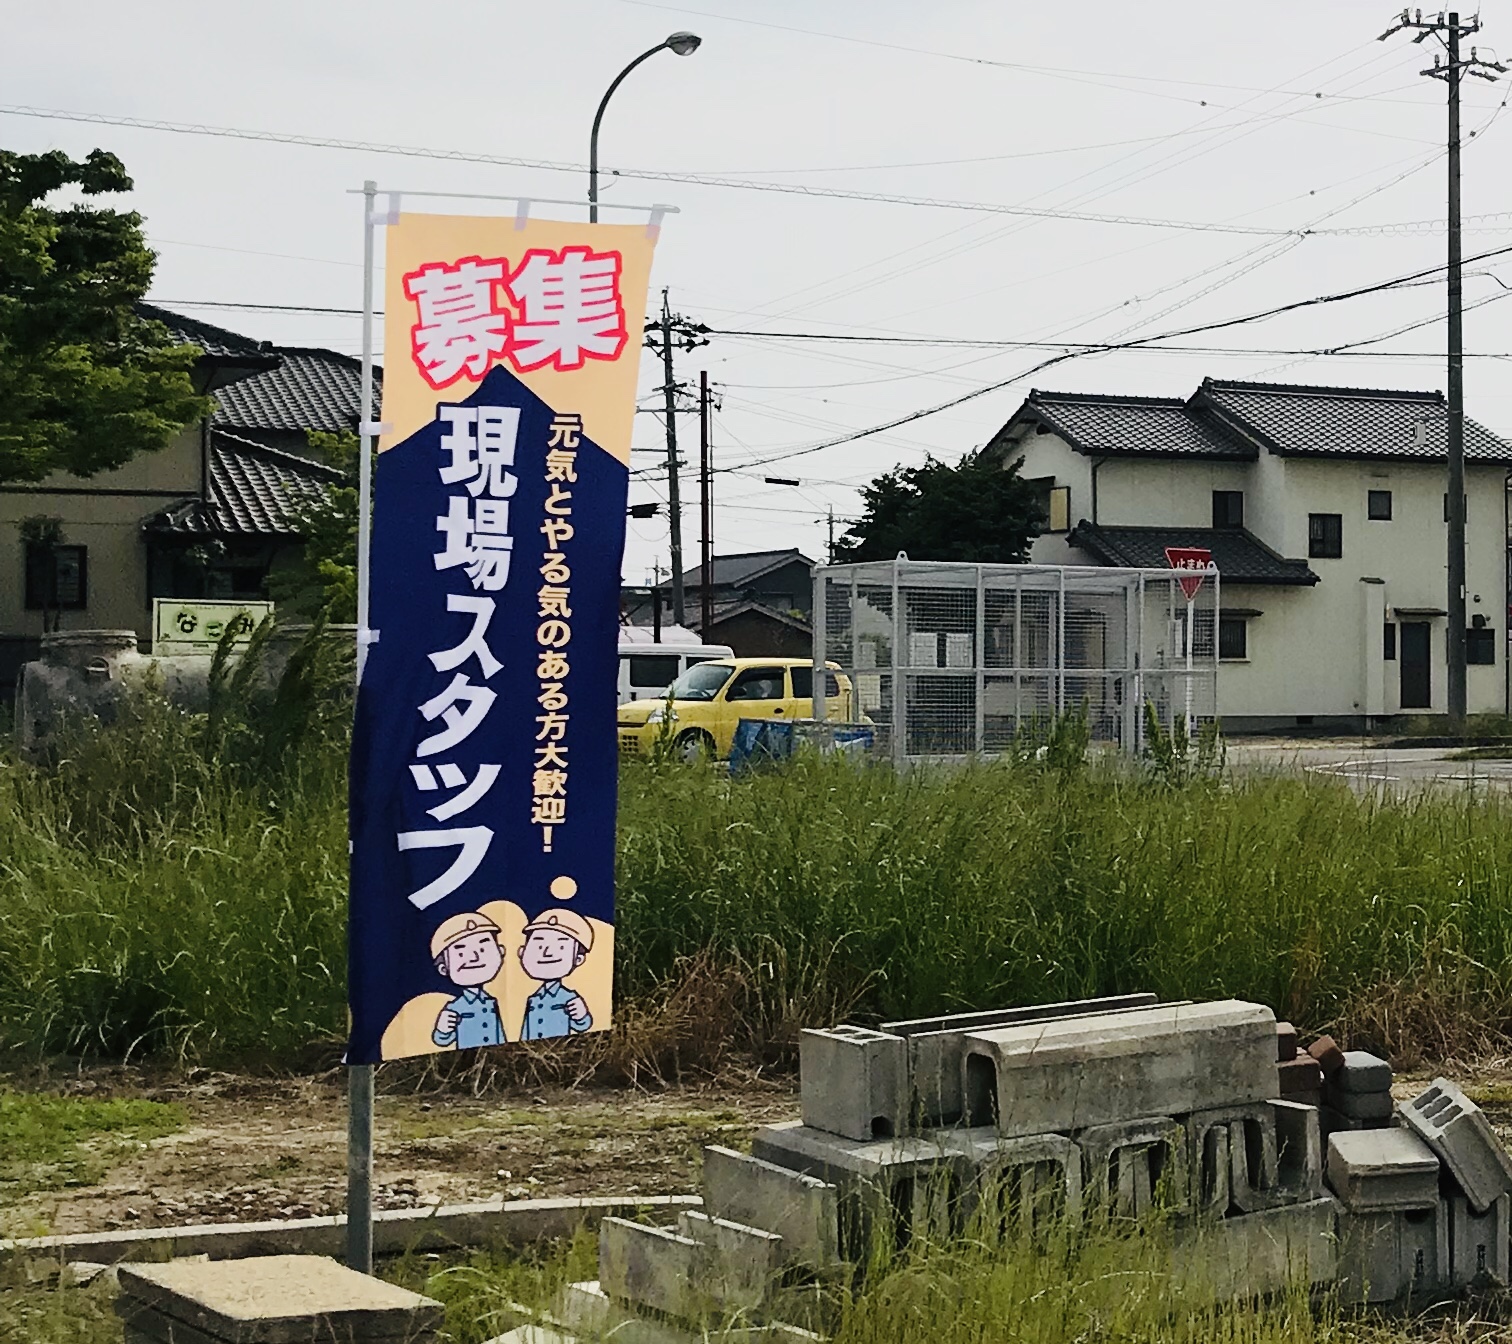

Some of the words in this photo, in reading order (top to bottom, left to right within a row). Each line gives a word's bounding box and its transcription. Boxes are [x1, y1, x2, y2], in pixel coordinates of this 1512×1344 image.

[403, 246, 628, 389] 募集
[397, 405, 522, 910] 現場スタッフ
[531, 414, 582, 852] 元気とやる気のある方大歓迎!
